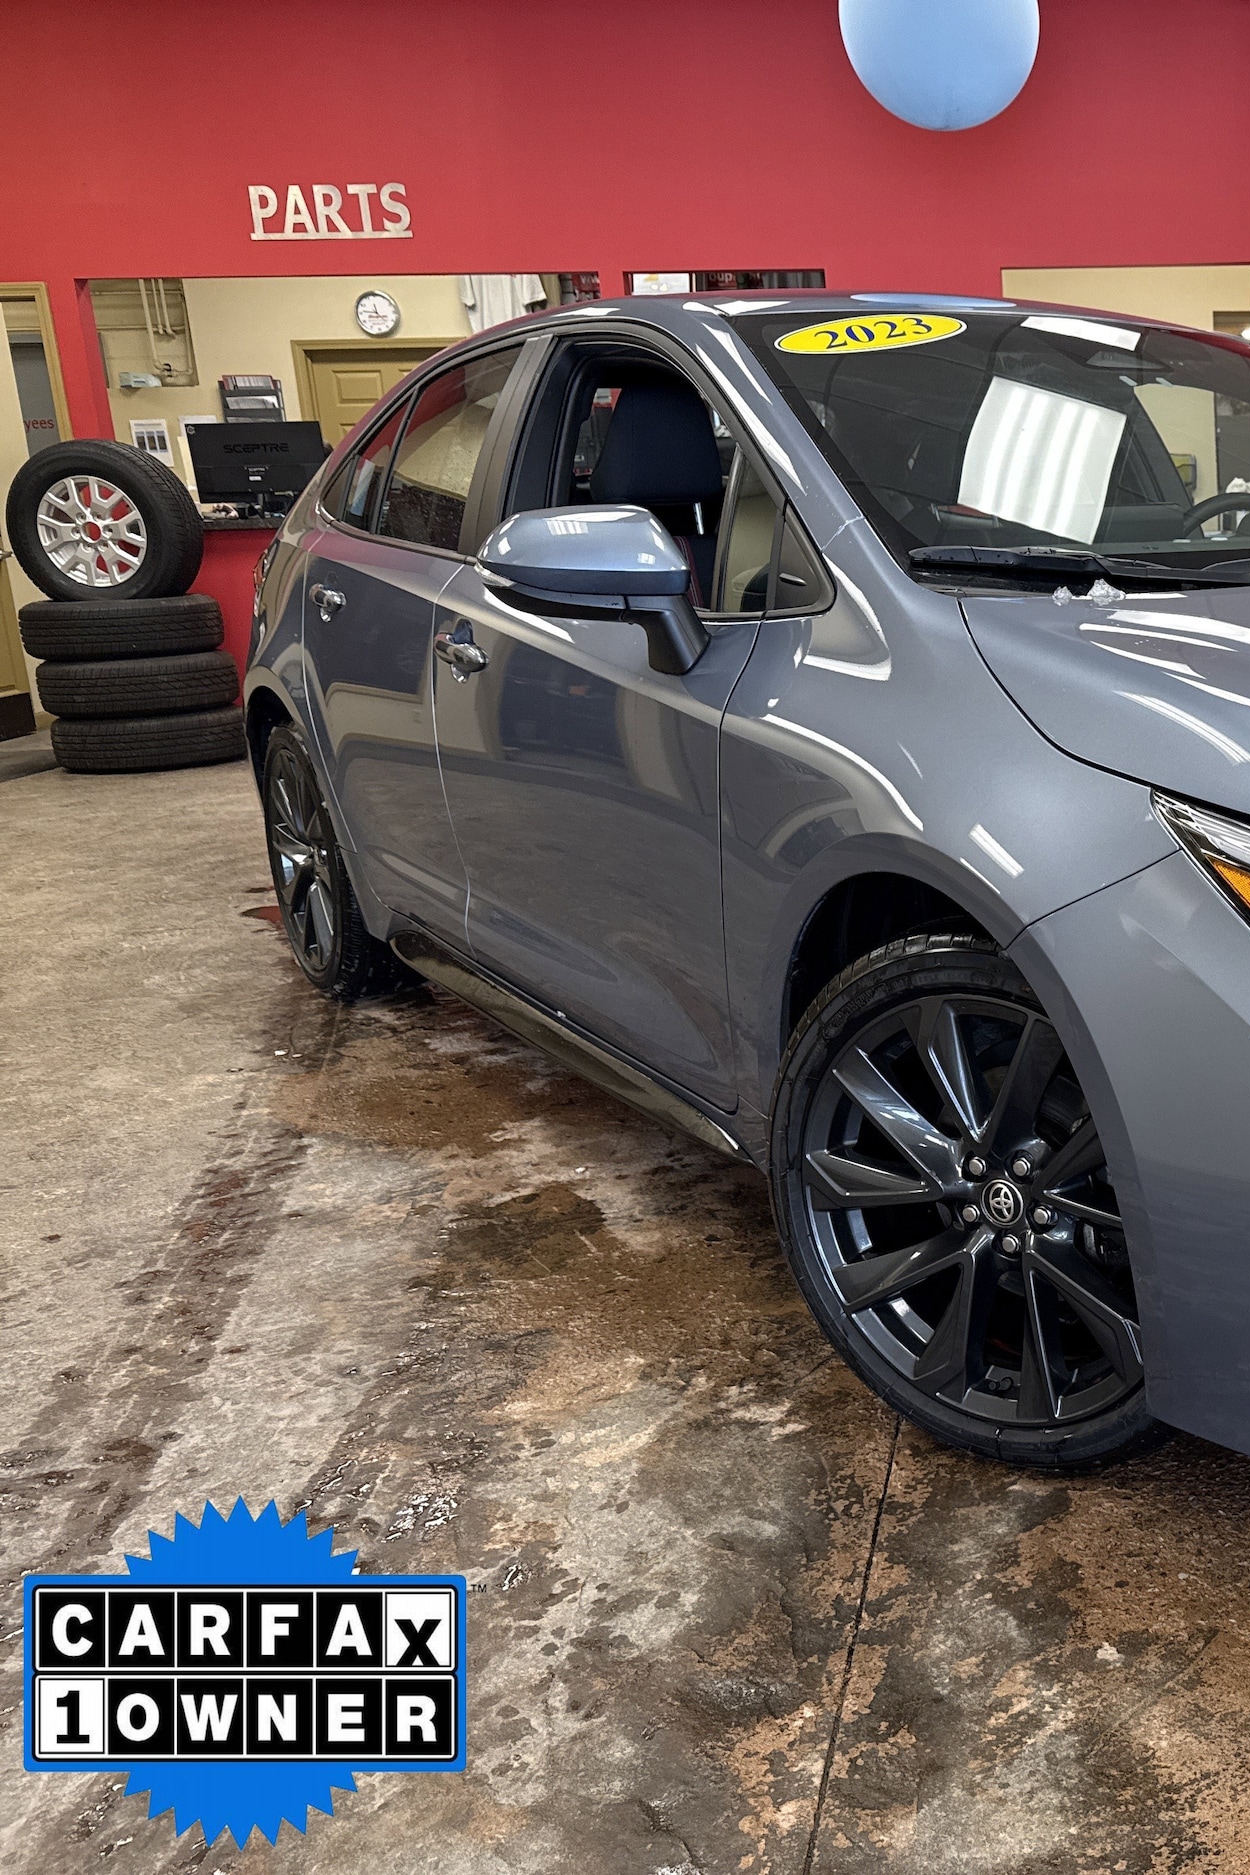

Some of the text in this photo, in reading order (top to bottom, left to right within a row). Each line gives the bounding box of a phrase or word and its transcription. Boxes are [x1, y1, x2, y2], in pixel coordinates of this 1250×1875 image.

[248, 182, 412, 236] PARTS
[813, 317, 933, 350] 2023
[223, 443, 290, 454] SCEPTRE
